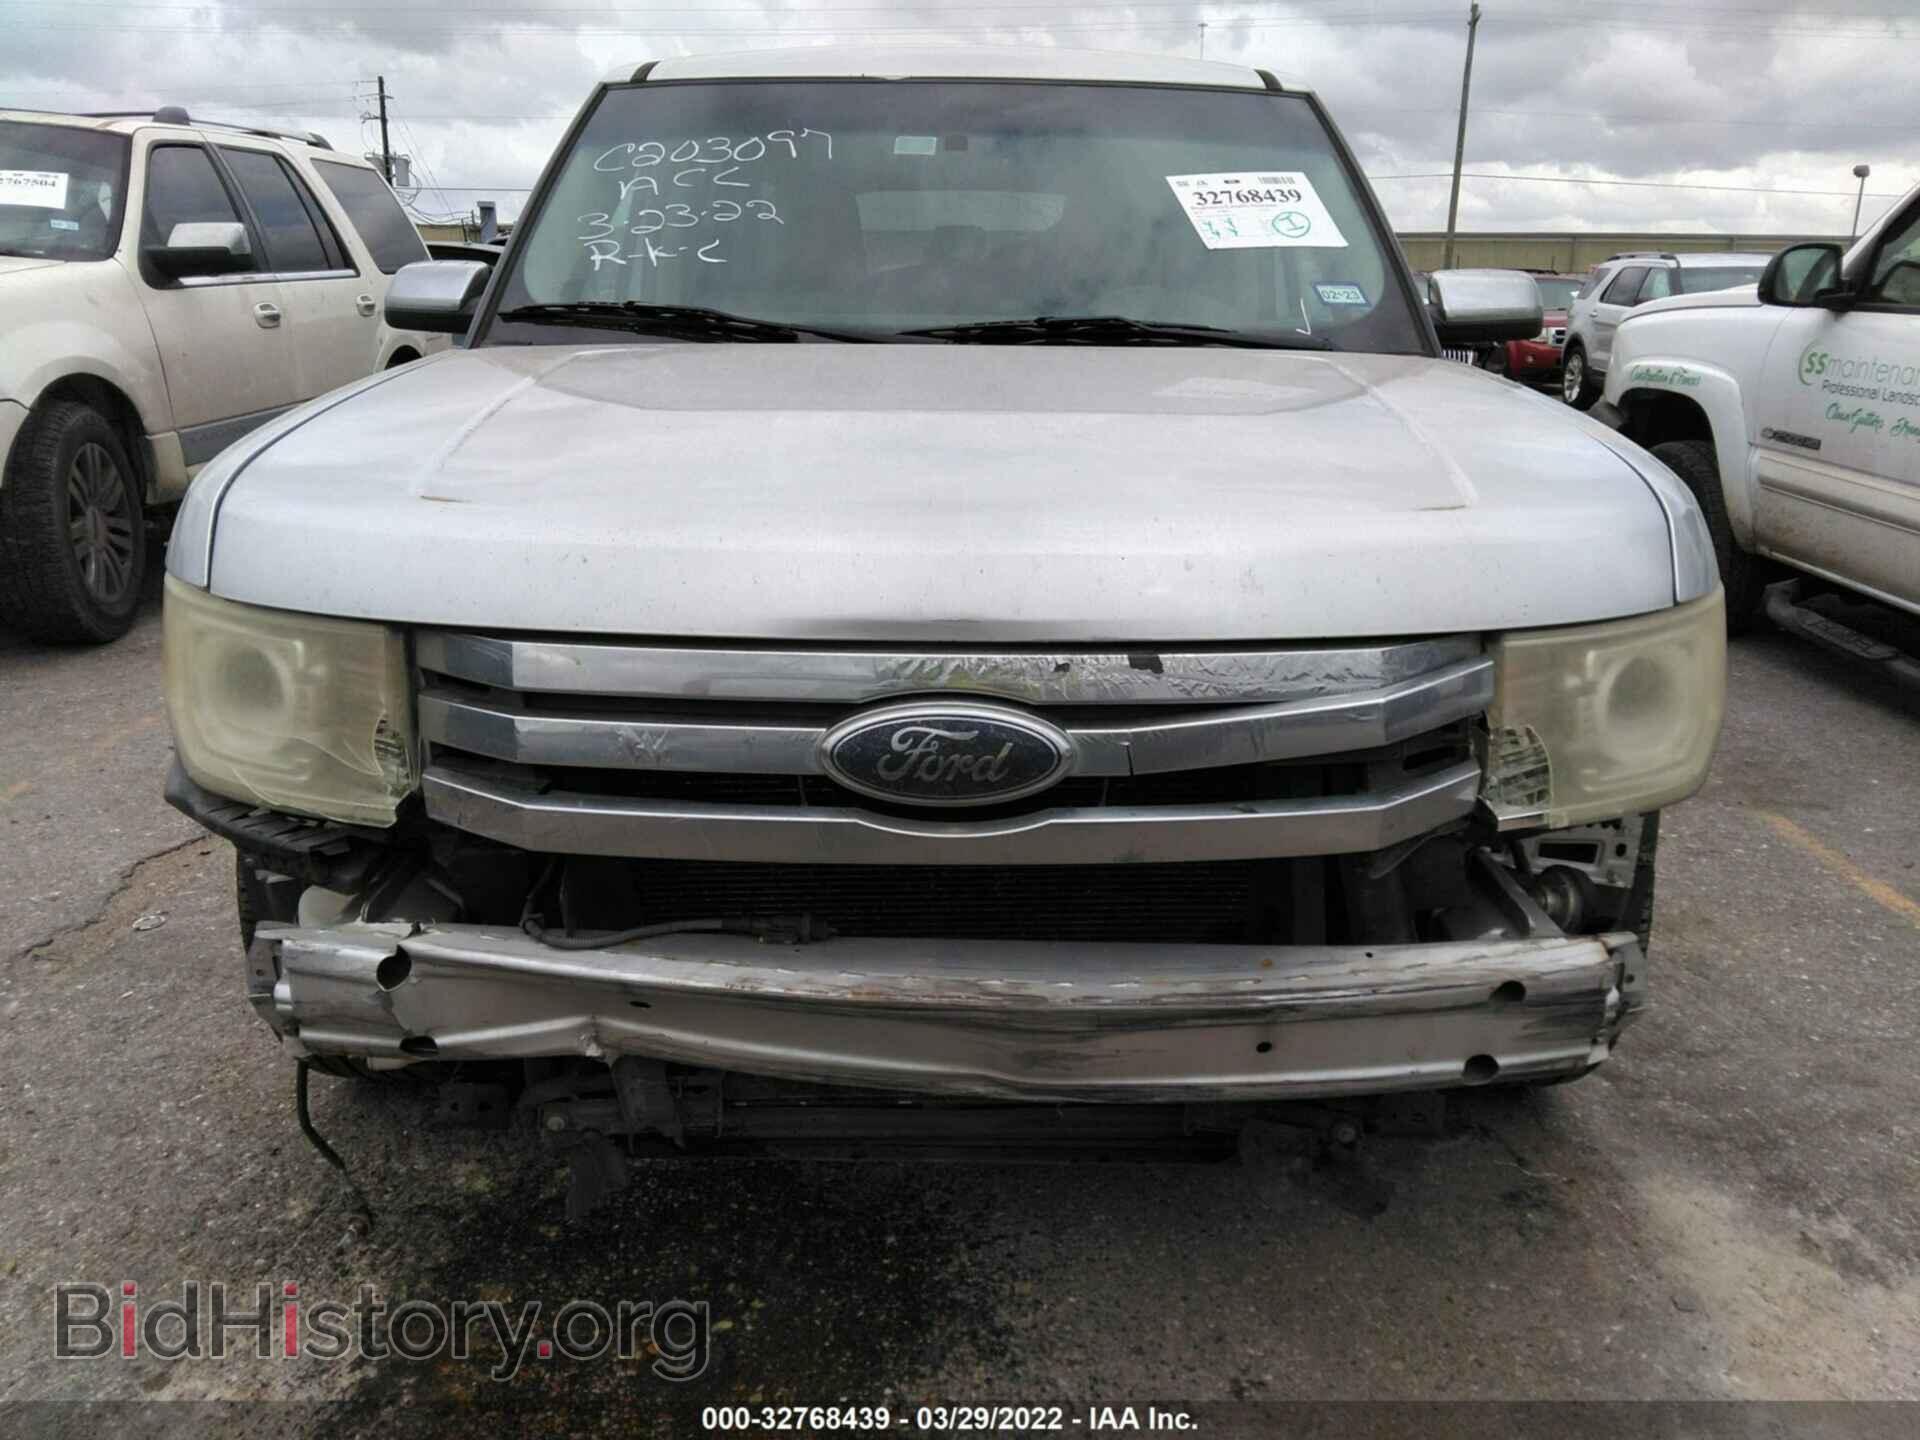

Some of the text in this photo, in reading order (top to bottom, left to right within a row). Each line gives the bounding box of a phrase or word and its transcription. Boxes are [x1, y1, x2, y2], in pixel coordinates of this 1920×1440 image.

[1192, 188, 1302, 206] 32768439
[1822, 379, 1879, 400] Professional
[876, 726, 1014, 782] Ford
